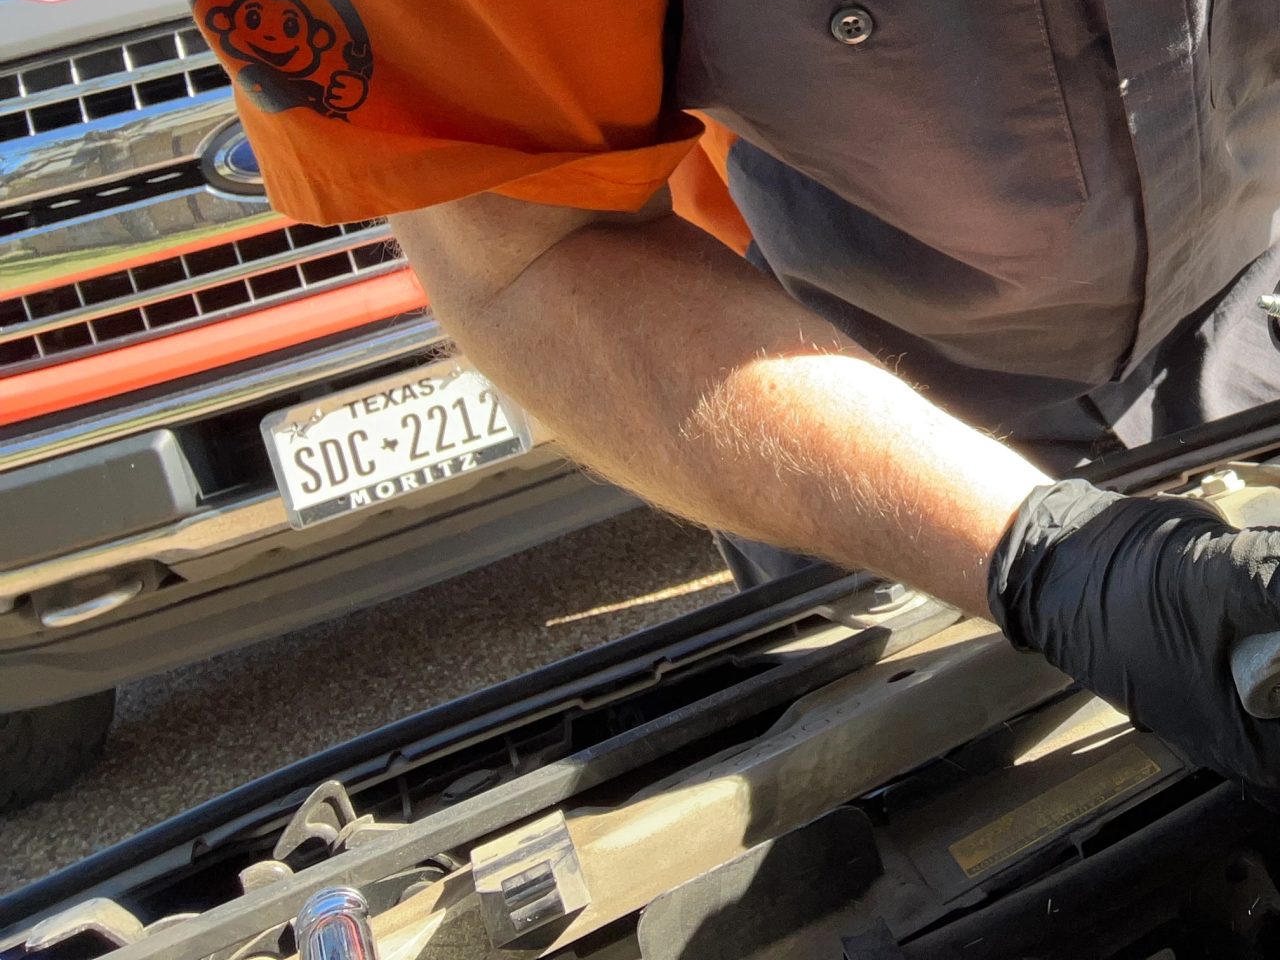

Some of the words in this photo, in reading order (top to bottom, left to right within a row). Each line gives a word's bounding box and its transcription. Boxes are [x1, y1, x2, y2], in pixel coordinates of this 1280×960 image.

[343, 377, 435, 420] TEXAS
[293, 429, 376, 494] SDC
[401, 389, 508, 462] 2212
[350, 452, 478, 510] MORITZ
